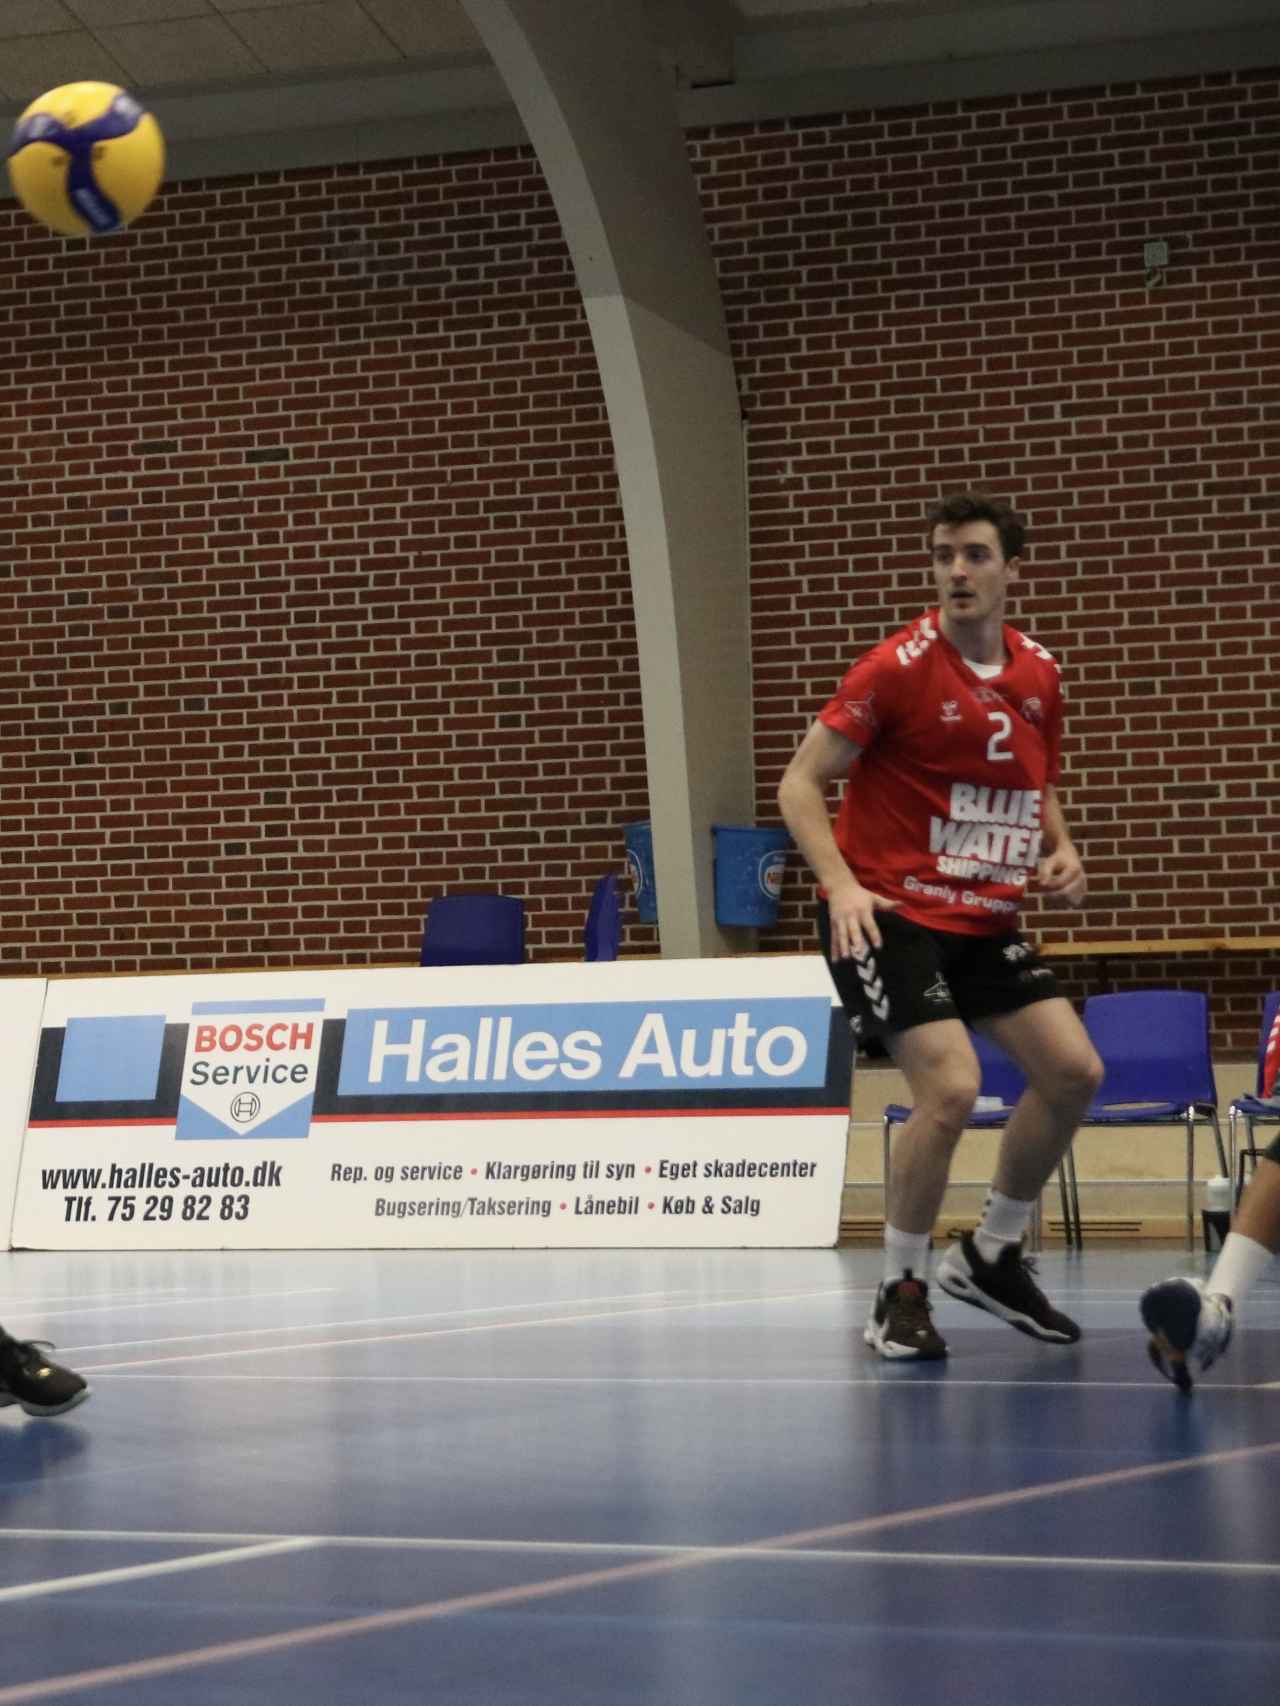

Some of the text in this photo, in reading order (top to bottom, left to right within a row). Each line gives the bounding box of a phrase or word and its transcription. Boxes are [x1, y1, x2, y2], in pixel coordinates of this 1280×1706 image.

[986, 710, 1014, 761] 2
[949, 782, 1042, 829] BLUE
[935, 855, 1028, 886] SHIPPING
[903, 875, 957, 904] Granly
[194, 1022, 314, 1053] BOSCH
[367, 1012, 808, 1083] Halles Auto
[190, 1057, 309, 1086] Service
[40, 1160, 283, 1190] www.halles-auto.dk
[330, 1158, 817, 1184] Rep. og service Klargøring til syn Eget skadecenter
[64, 1194, 250, 1222] Tlf. 75 29 82 83
[374, 1194, 761, 1219] Bugsering/Taksering Lånebil Køb & Salg
